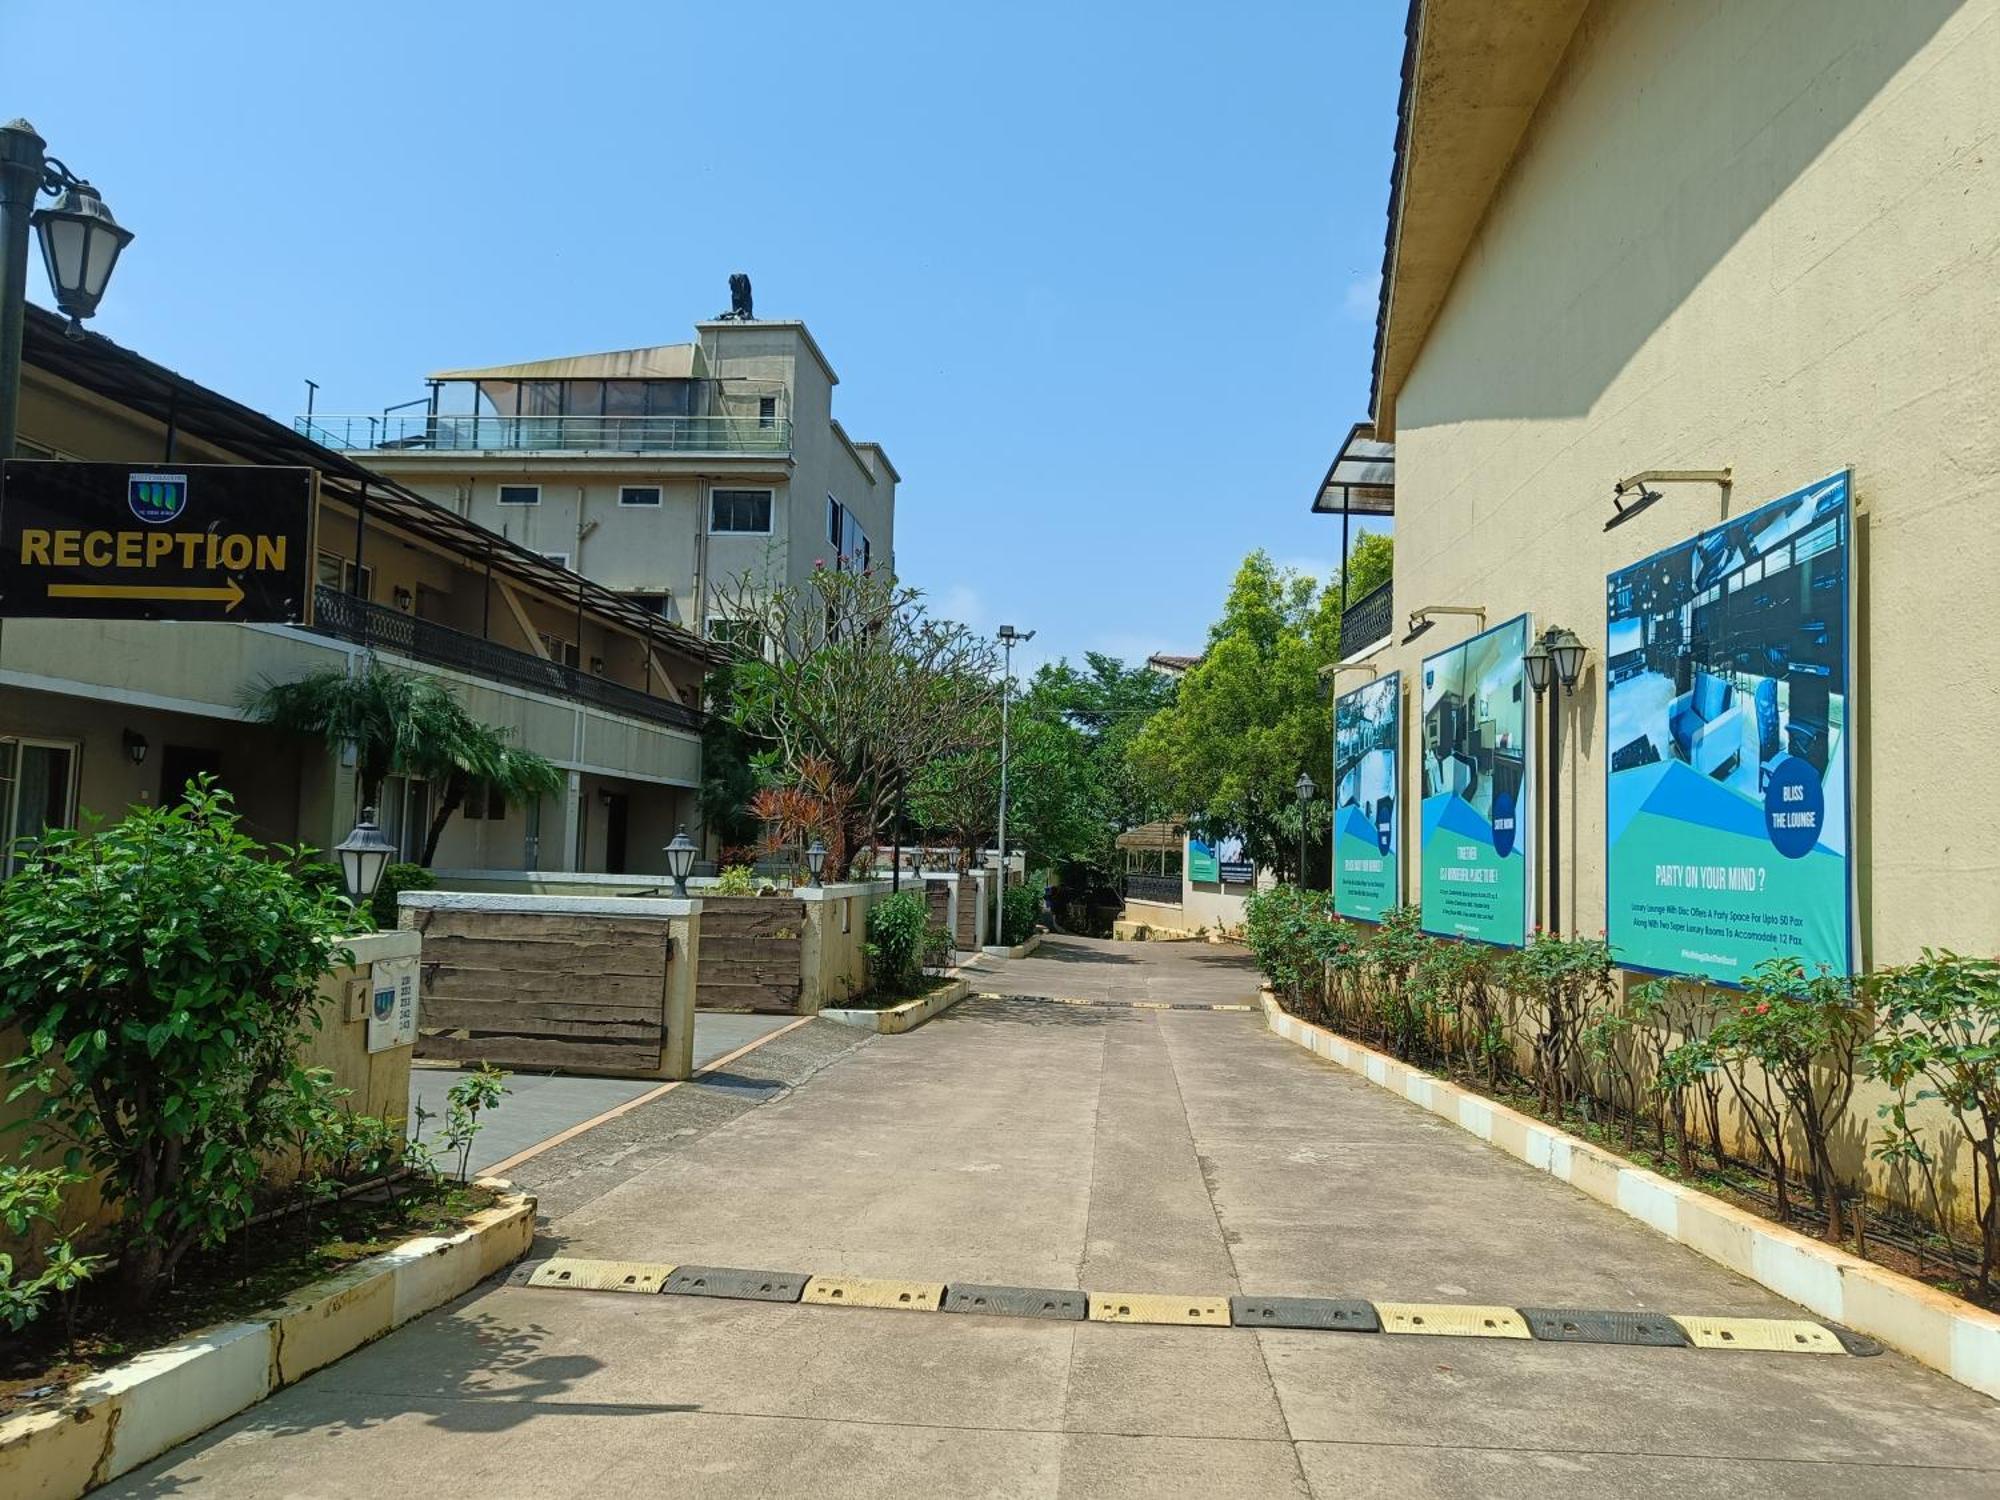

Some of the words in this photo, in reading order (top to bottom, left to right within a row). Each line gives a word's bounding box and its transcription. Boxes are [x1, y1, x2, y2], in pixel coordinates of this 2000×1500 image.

[20, 528, 287, 572] RECEPTION
[1783, 785, 1803, 802] BLISS
[1772, 813, 1786, 828] THE
[1788, 811, 1816, 828] LOUNGE
[1655, 865, 1683, 887] PARTY
[1685, 866, 1698, 888] ON
[1700, 866, 1726, 890] YOUR
[1728, 867, 1756, 892] MIND
[1758, 867, 1766, 892] ?
[1714, 910, 1728, 922] Party
[1730, 911, 1750, 922] Space
[1751, 912, 1761, 923] For
[1762, 913, 1778, 926] Upto
[1790, 916, 1804, 927] Pax
[1687, 923, 1704, 936] Luxury
[1705, 926, 1724, 936] Rooms
[1726, 928, 1733, 938] To
[1779, 934, 1788, 944] 12
[358, 988, 366, 1014] 1
